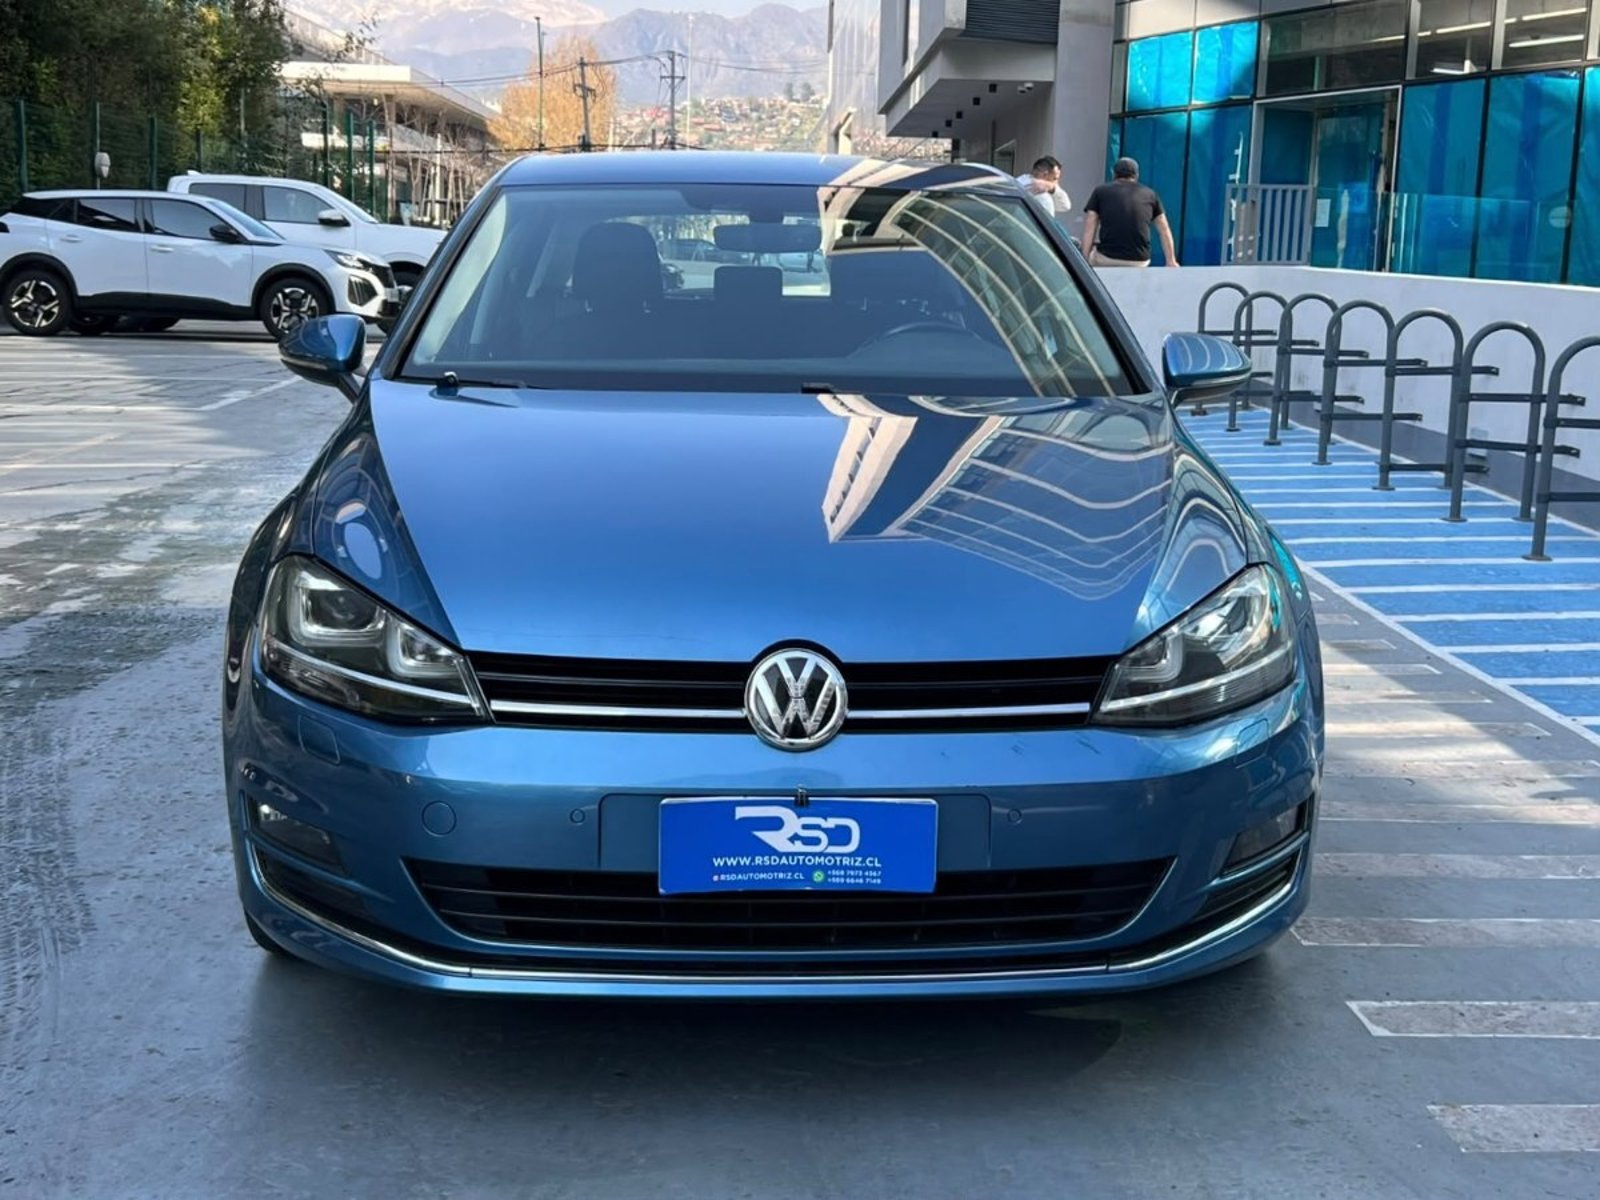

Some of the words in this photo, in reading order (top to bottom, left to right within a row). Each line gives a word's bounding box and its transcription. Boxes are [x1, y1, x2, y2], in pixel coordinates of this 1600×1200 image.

[746, 649, 846, 747] VW
[735, 806, 860, 853] RSD
[712, 855, 882, 867] WWW.RSDAUTOMOTRIZ.CL
